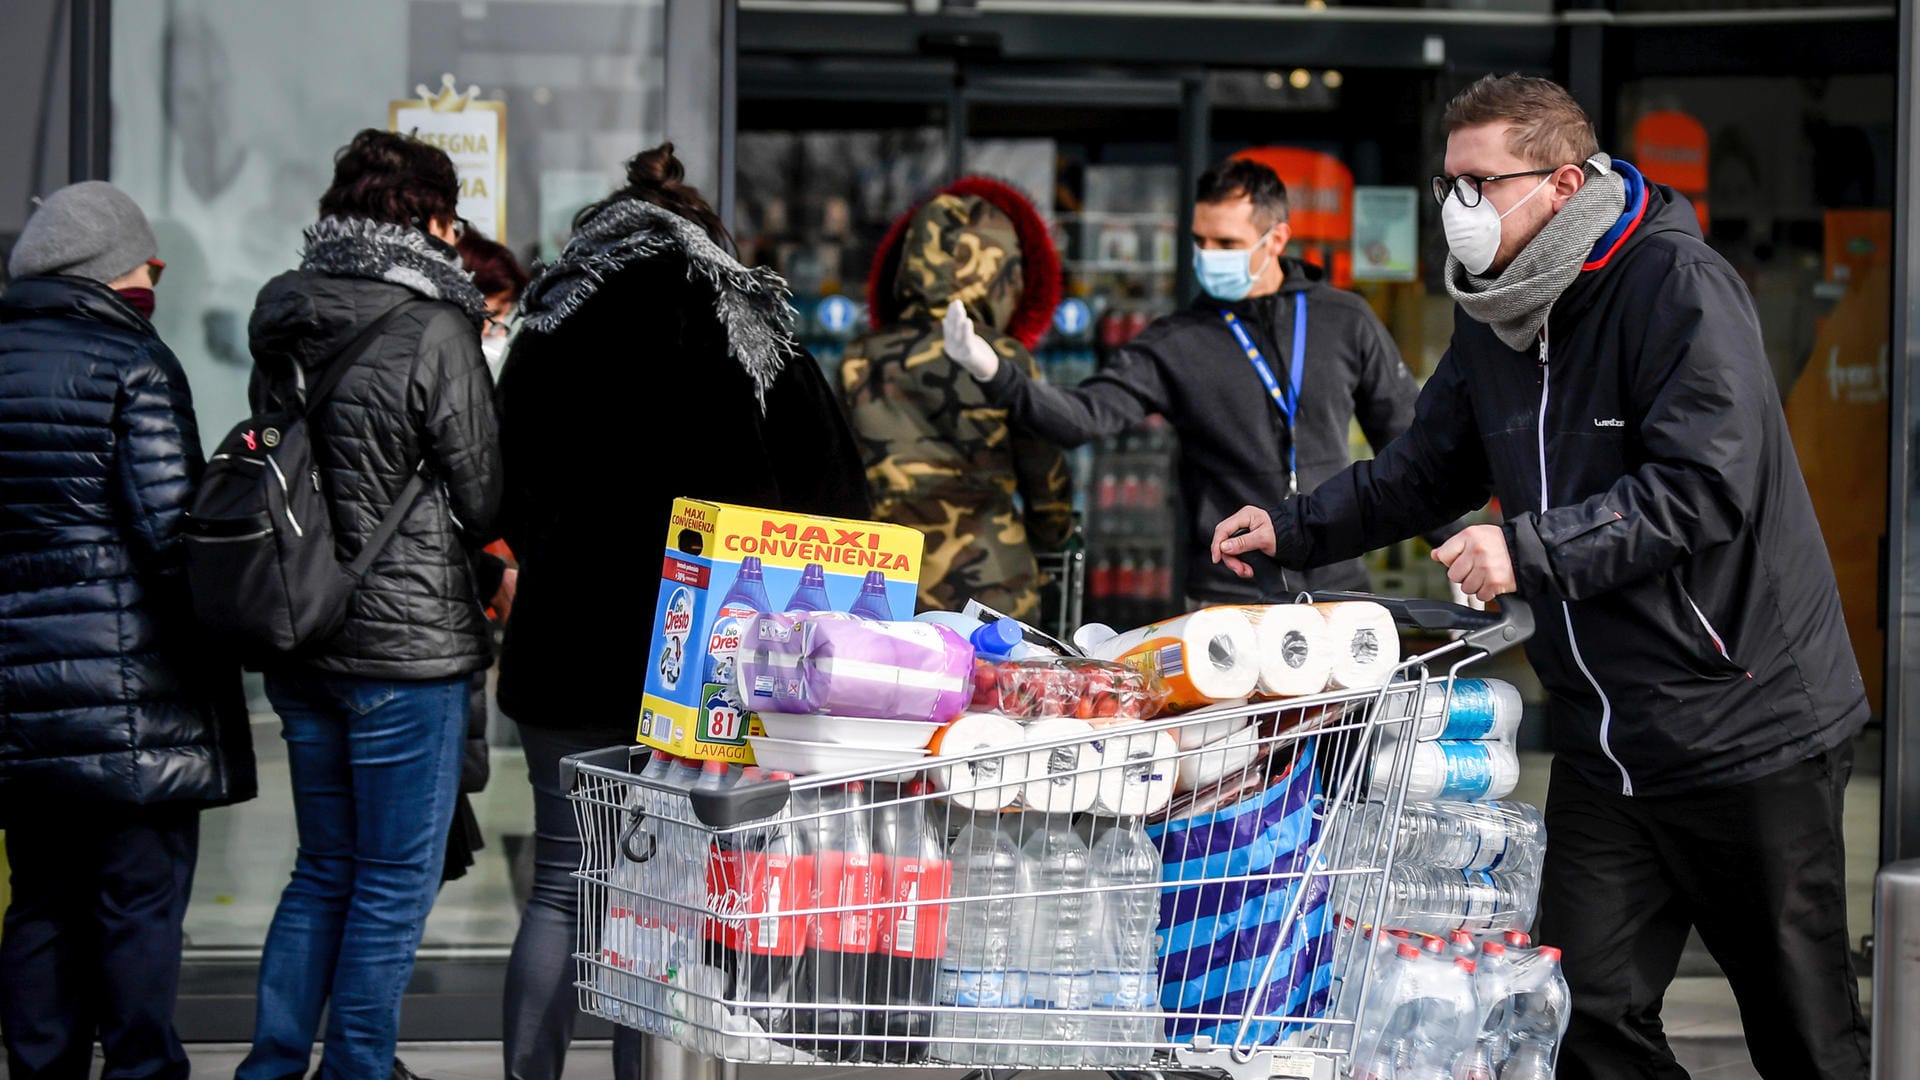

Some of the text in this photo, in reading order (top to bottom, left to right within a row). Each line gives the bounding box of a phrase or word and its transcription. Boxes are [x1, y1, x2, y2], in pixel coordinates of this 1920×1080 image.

[672, 514, 715, 534] CONVENIENZA
[684, 507, 706, 521] MAXI
[761, 520, 880, 550] MAXI
[725, 534, 910, 571] CONVENIENZA
[664, 610, 689, 635] Presto
[725, 626, 738, 637] bio
[709, 635, 738, 653] Pres
[711, 711, 734, 737] 81
[694, 743, 746, 759] LAVAGGI
